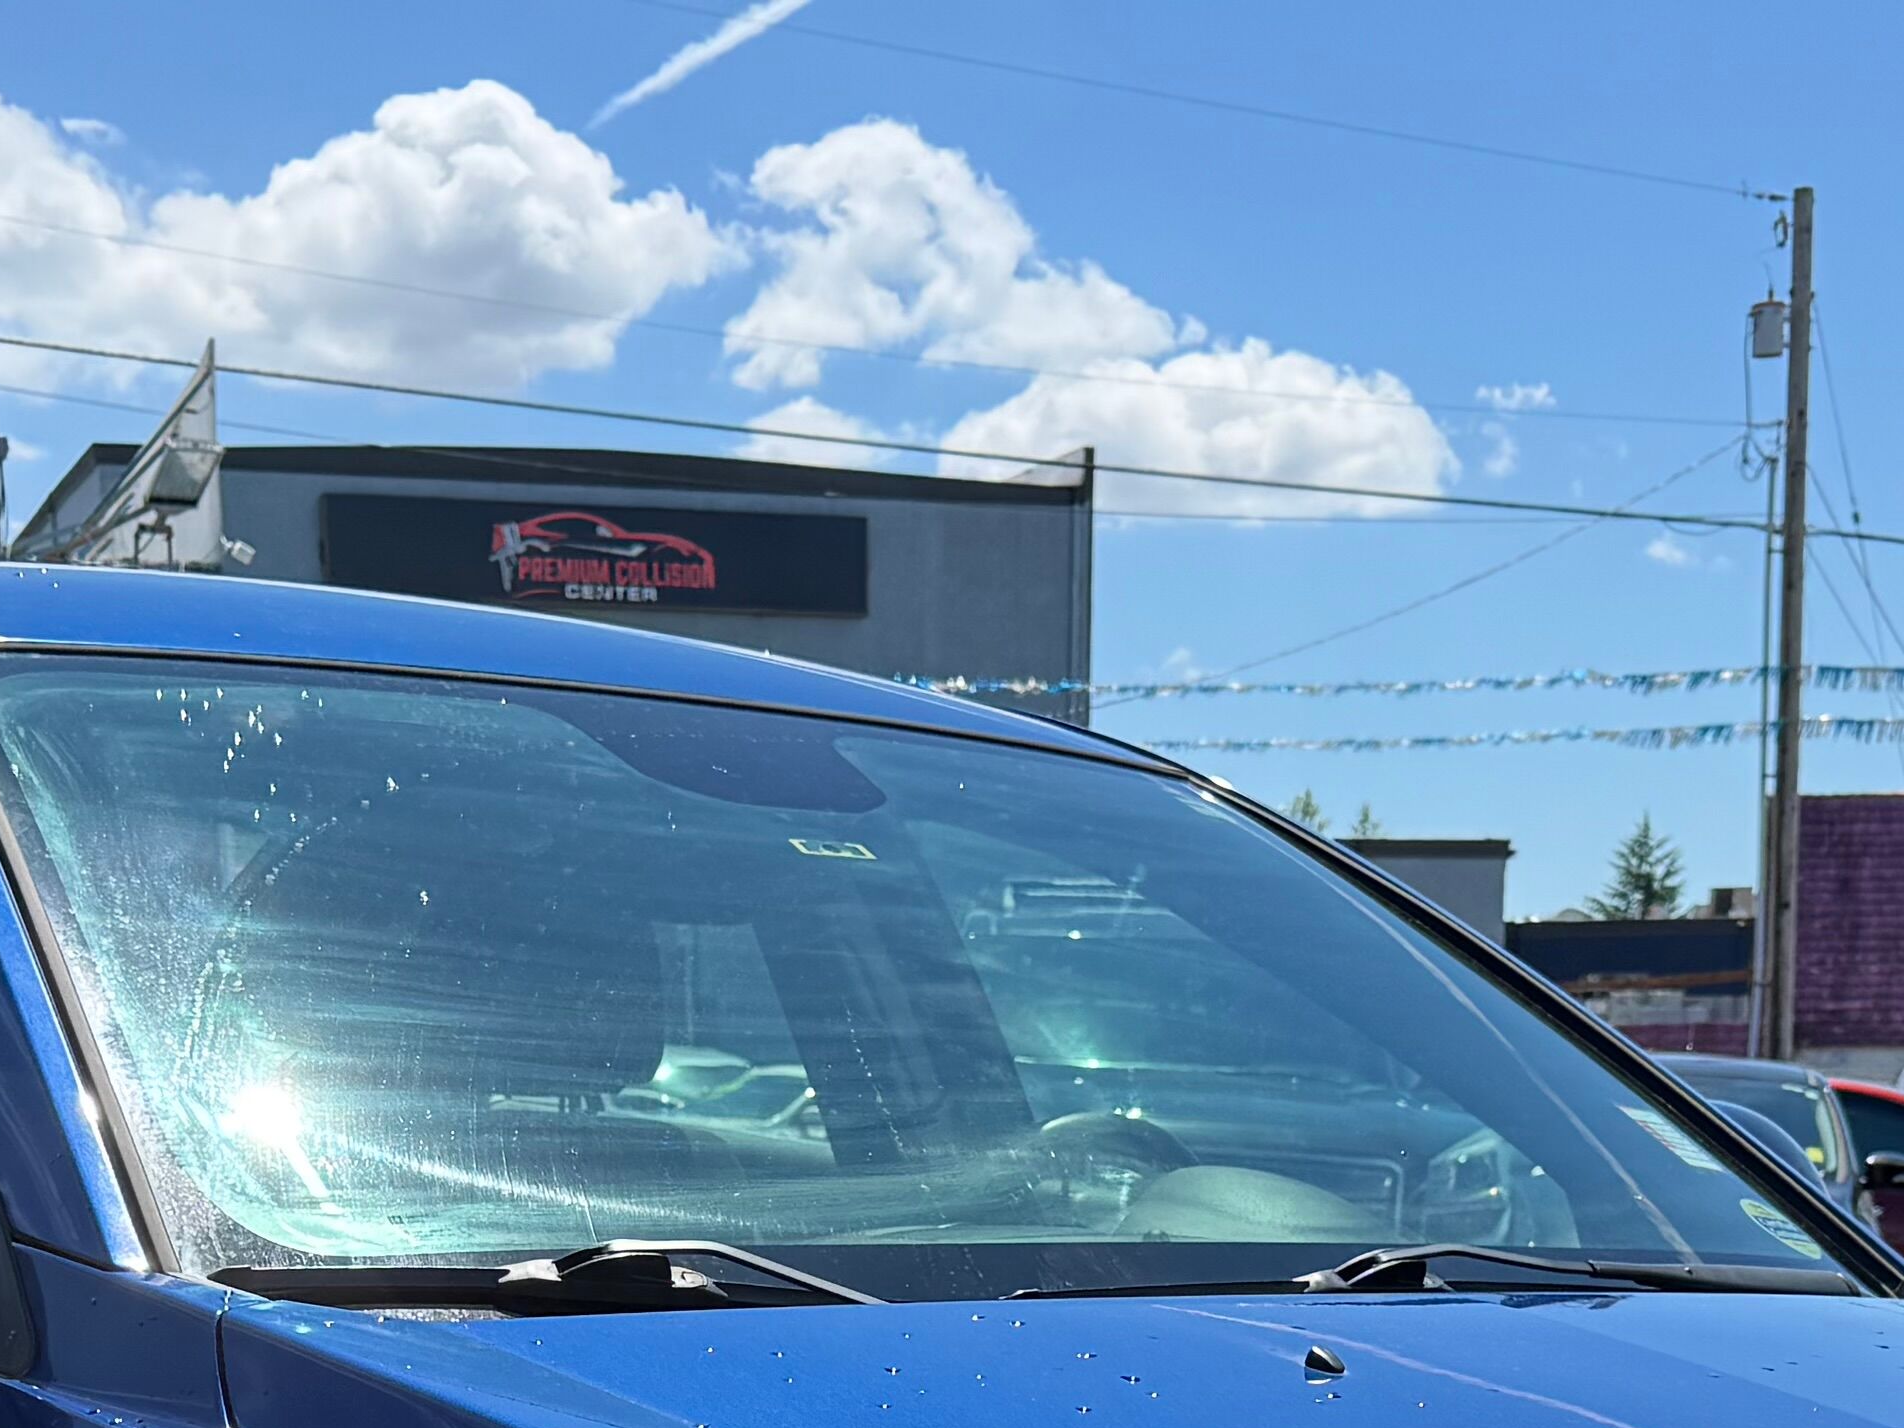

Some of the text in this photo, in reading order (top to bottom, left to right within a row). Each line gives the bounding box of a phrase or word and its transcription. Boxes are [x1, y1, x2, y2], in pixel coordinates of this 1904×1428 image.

[518, 556, 714, 589] PREMIUM COLLISION
[564, 584, 658, 602] CENTER
